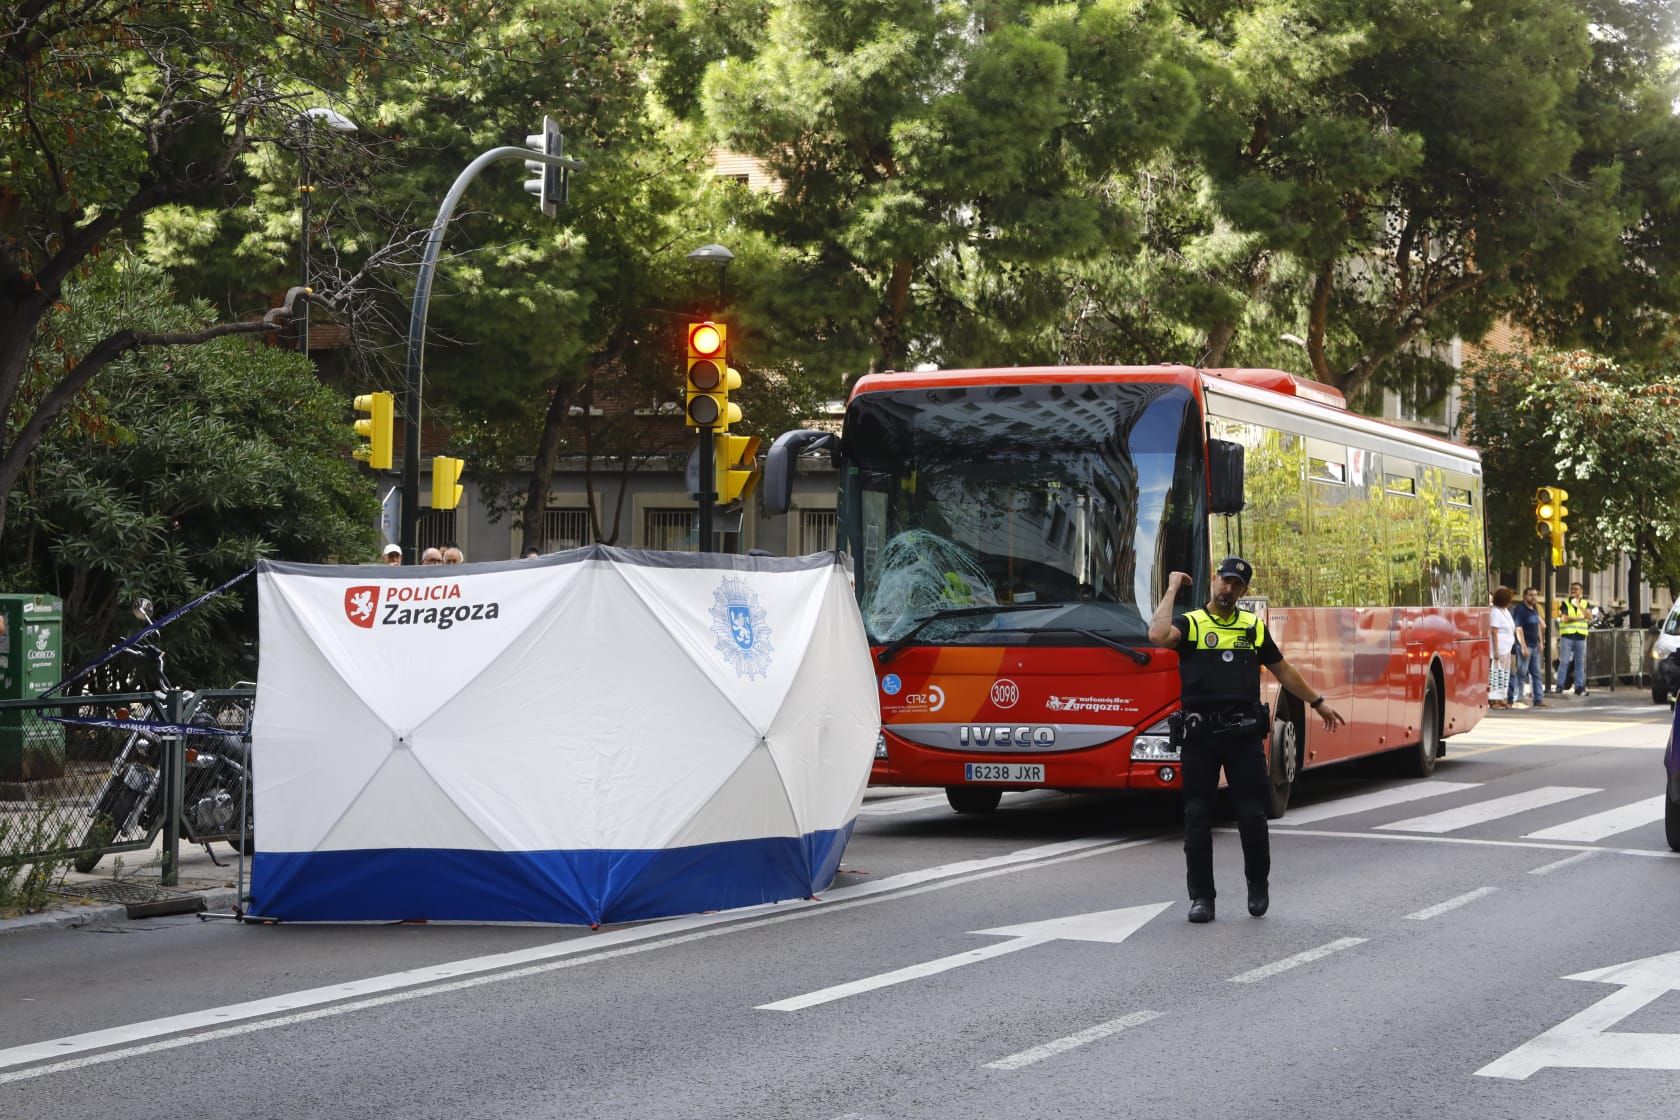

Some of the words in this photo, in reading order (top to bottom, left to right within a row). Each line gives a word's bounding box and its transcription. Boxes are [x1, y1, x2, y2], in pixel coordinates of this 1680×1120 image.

[386, 584, 461, 602] POLICIA
[382, 602, 499, 630] Zaragoza
[994, 685, 1016, 703] 3098
[960, 726, 1056, 748] IVECO
[975, 766, 1010, 779] 6238
[1015, 767, 1041, 780] JXR
